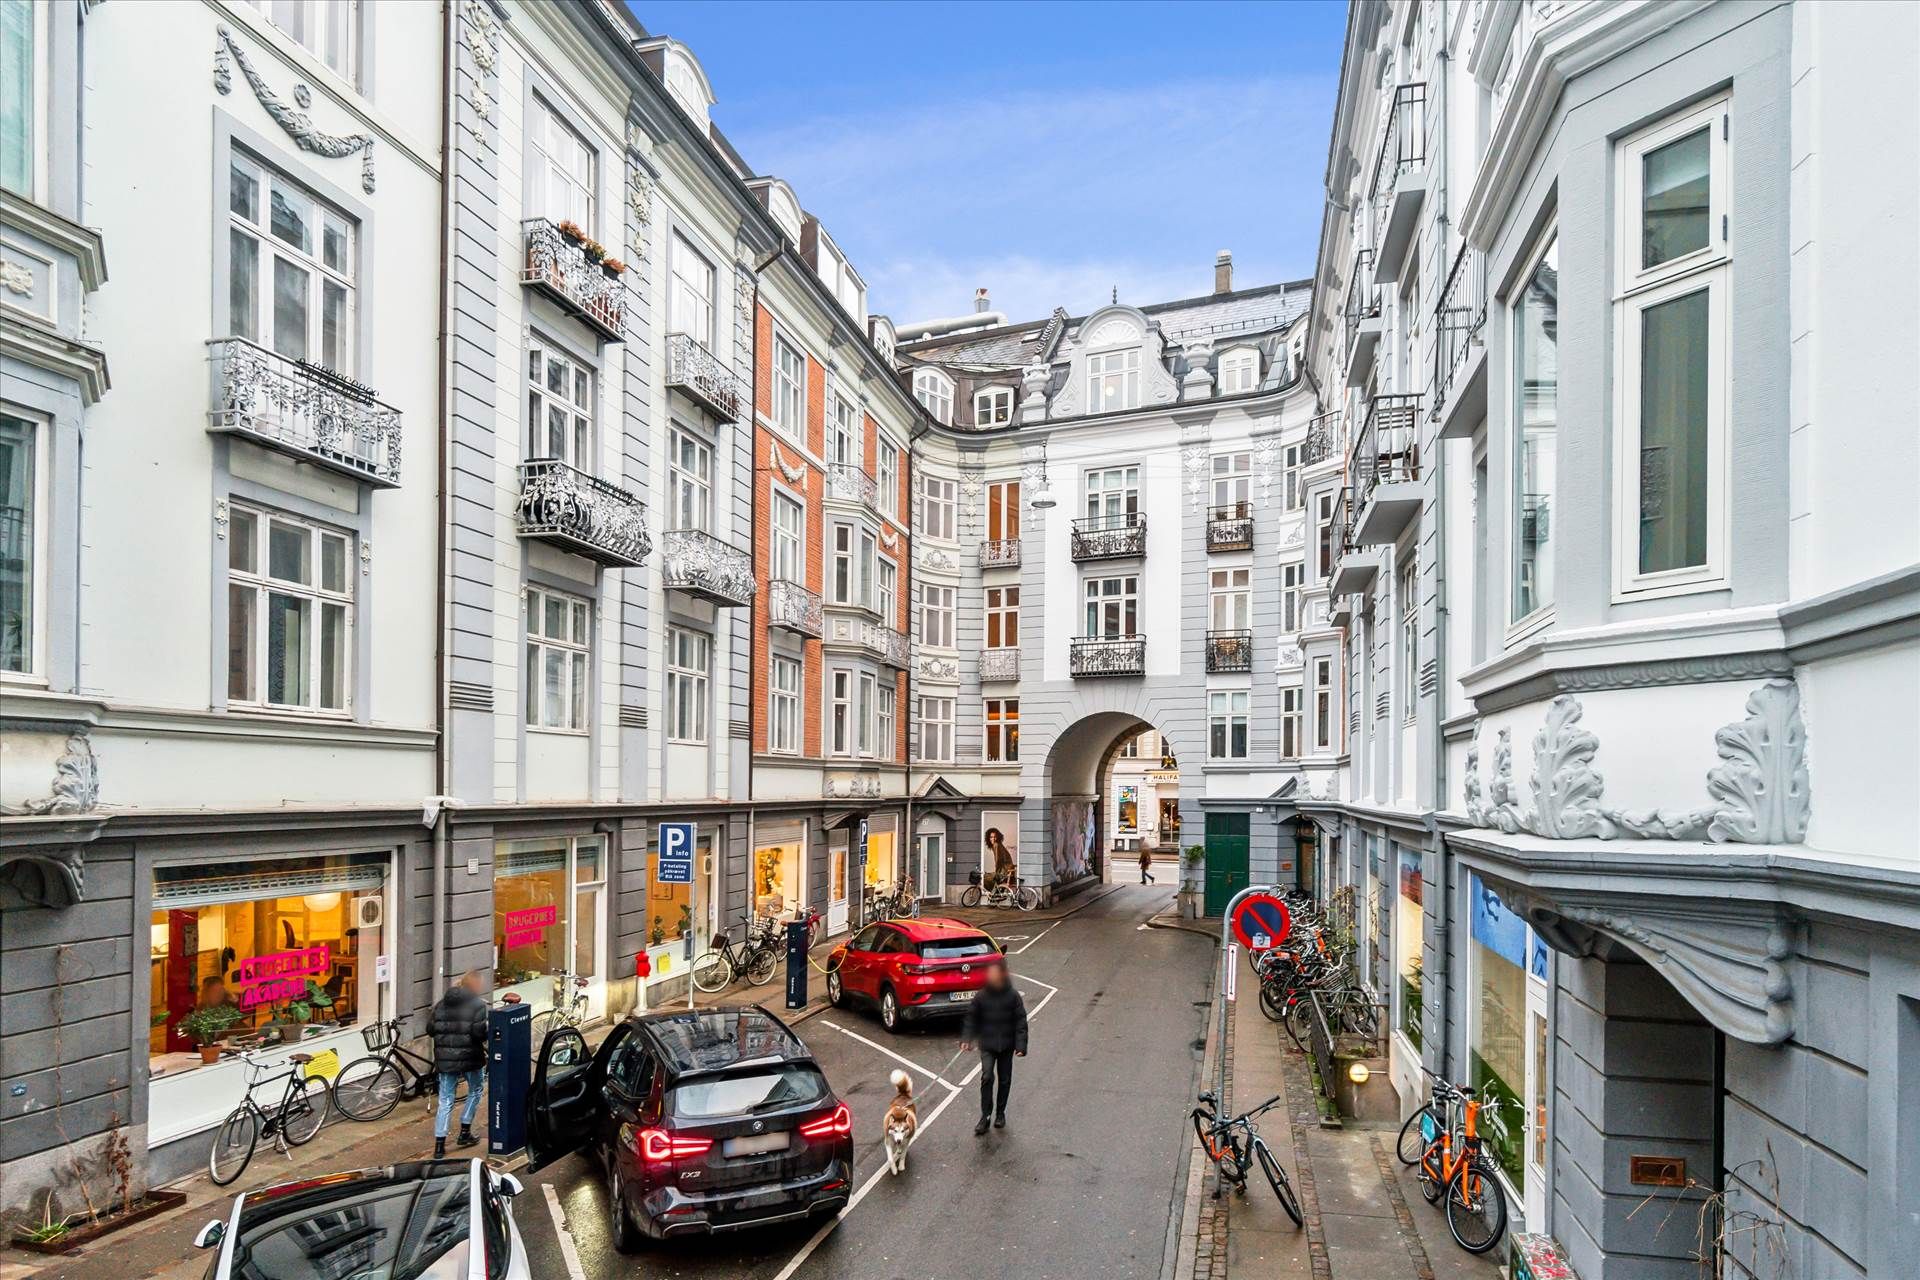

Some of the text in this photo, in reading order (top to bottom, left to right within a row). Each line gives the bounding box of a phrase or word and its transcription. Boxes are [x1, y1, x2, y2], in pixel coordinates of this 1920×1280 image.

[666, 828, 684, 856] P
[862, 822, 867, 843] P
[245, 950, 326, 980] BRUGERNES
[510, 1014, 529, 1024] Clever
